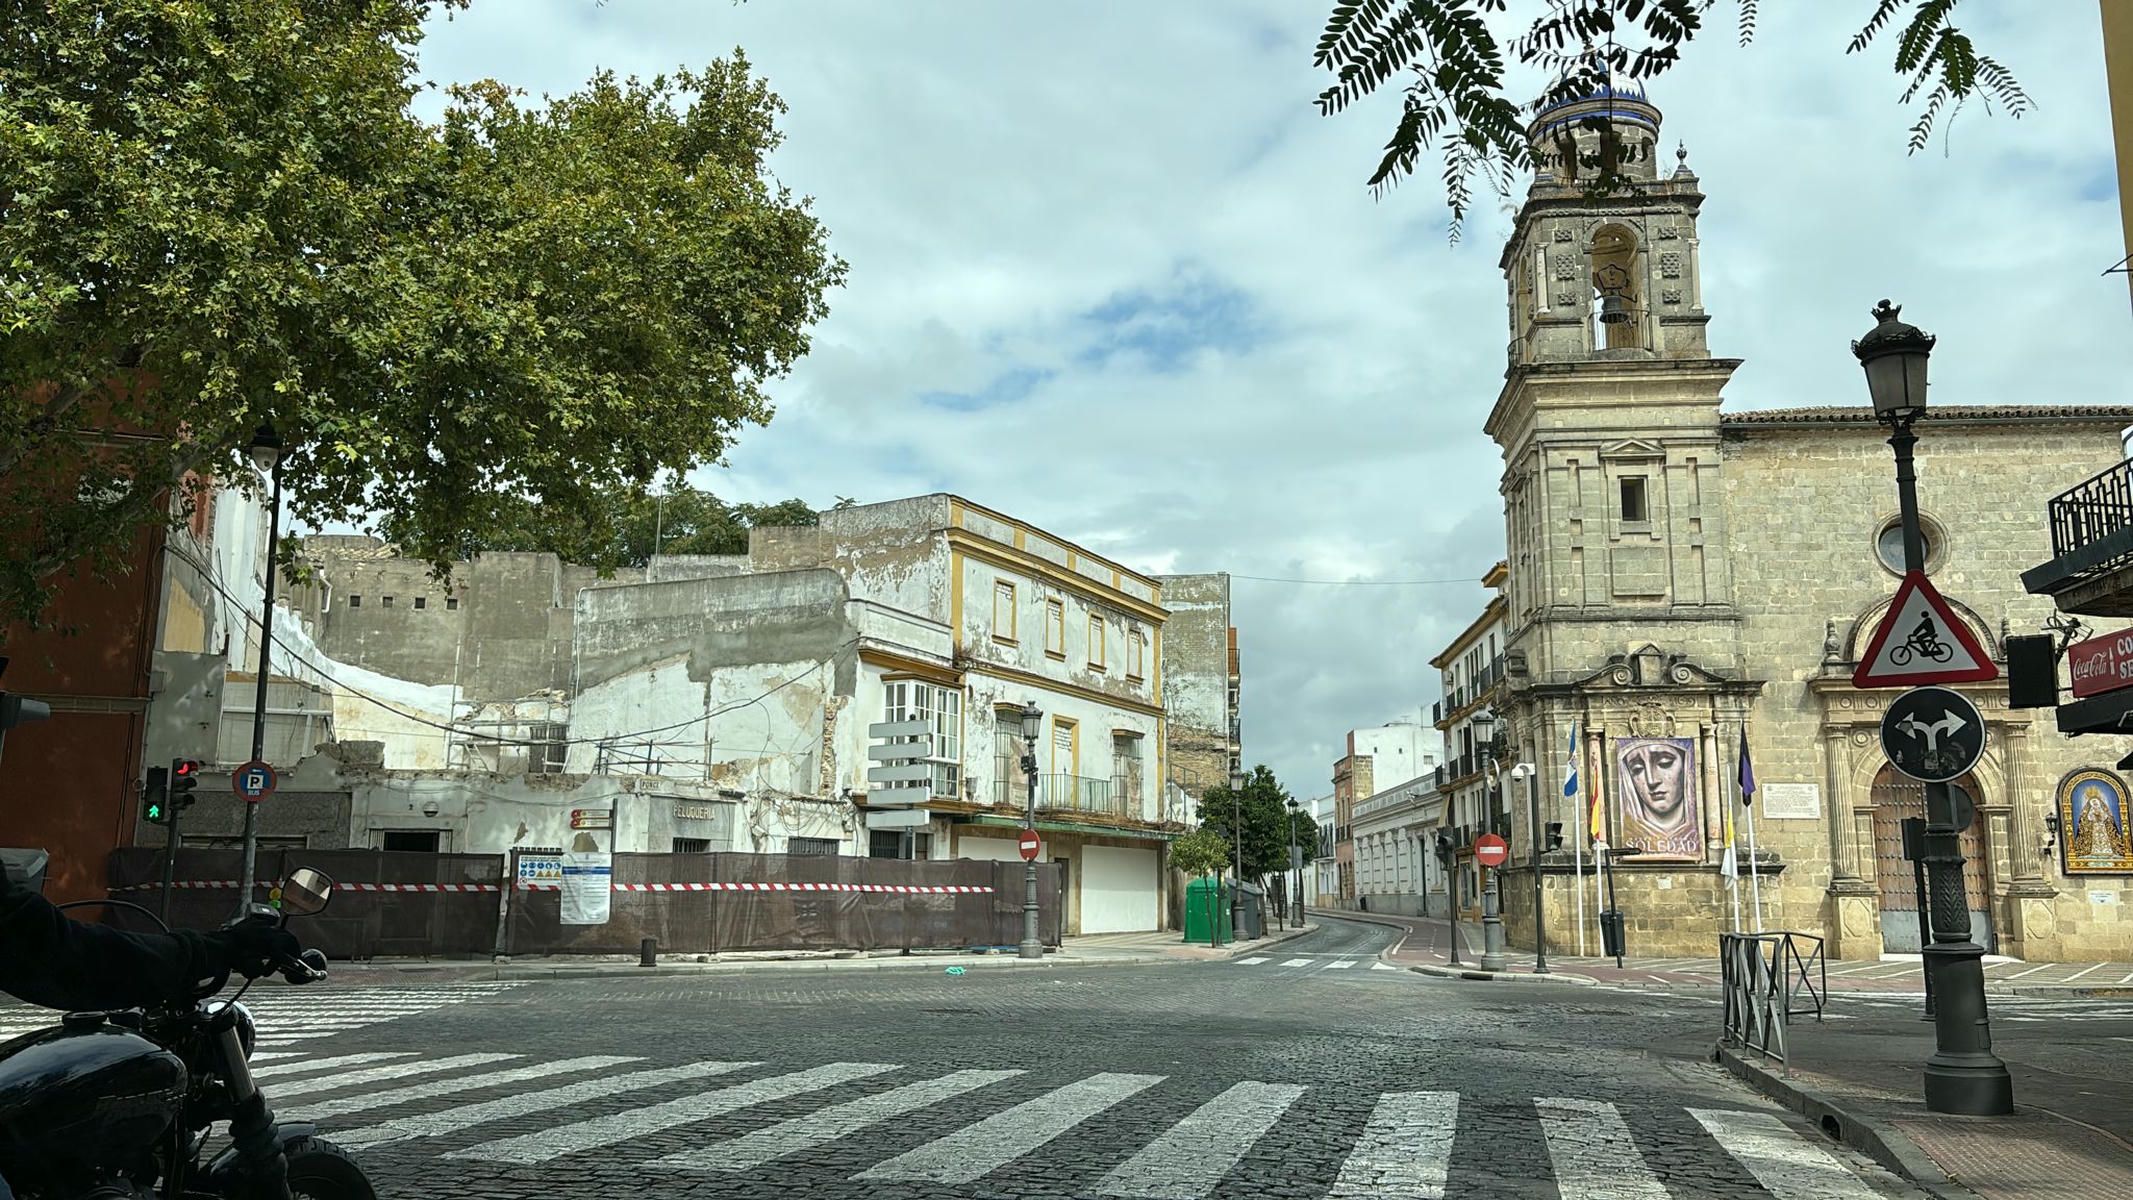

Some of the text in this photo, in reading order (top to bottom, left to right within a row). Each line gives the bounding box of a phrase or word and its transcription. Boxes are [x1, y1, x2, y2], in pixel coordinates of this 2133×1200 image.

[2117, 635, 2133, 656] CO
[250, 776, 260, 788] P
[1625, 839, 1697, 853] SOLEDAD
